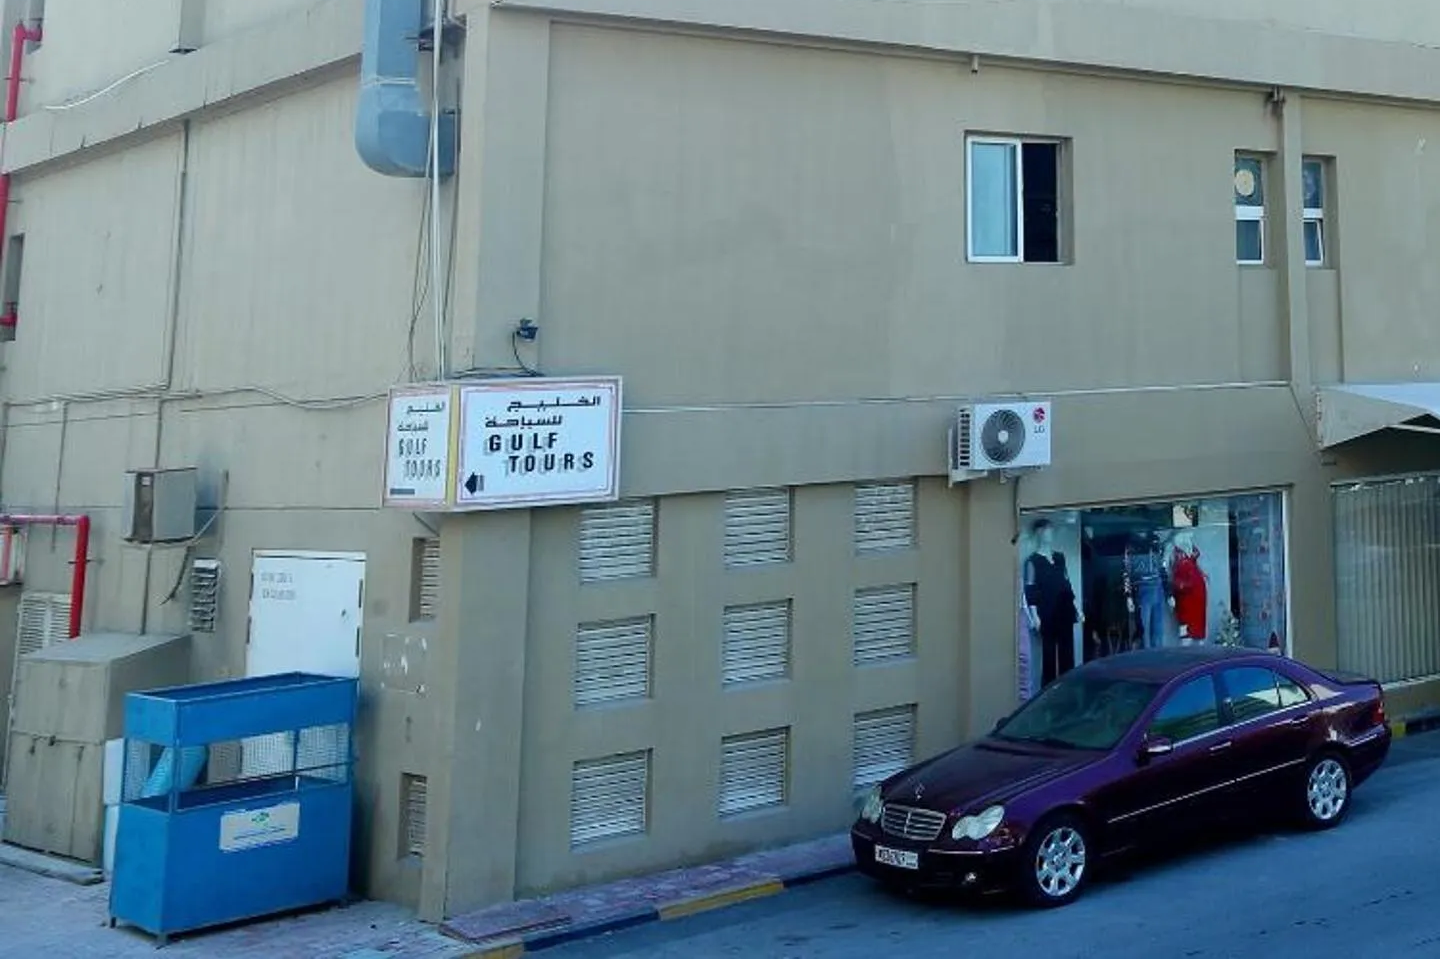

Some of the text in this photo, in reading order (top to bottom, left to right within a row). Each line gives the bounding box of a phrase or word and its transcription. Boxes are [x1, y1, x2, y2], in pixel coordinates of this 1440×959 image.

[507, 395, 601, 413] الخليج
[485, 415, 562, 430] للسياحة
[398, 438, 427, 458] GULF
[488, 432, 559, 453] GULF
[405, 460, 441, 478] TOURS
[507, 451, 594, 474] TOURS
